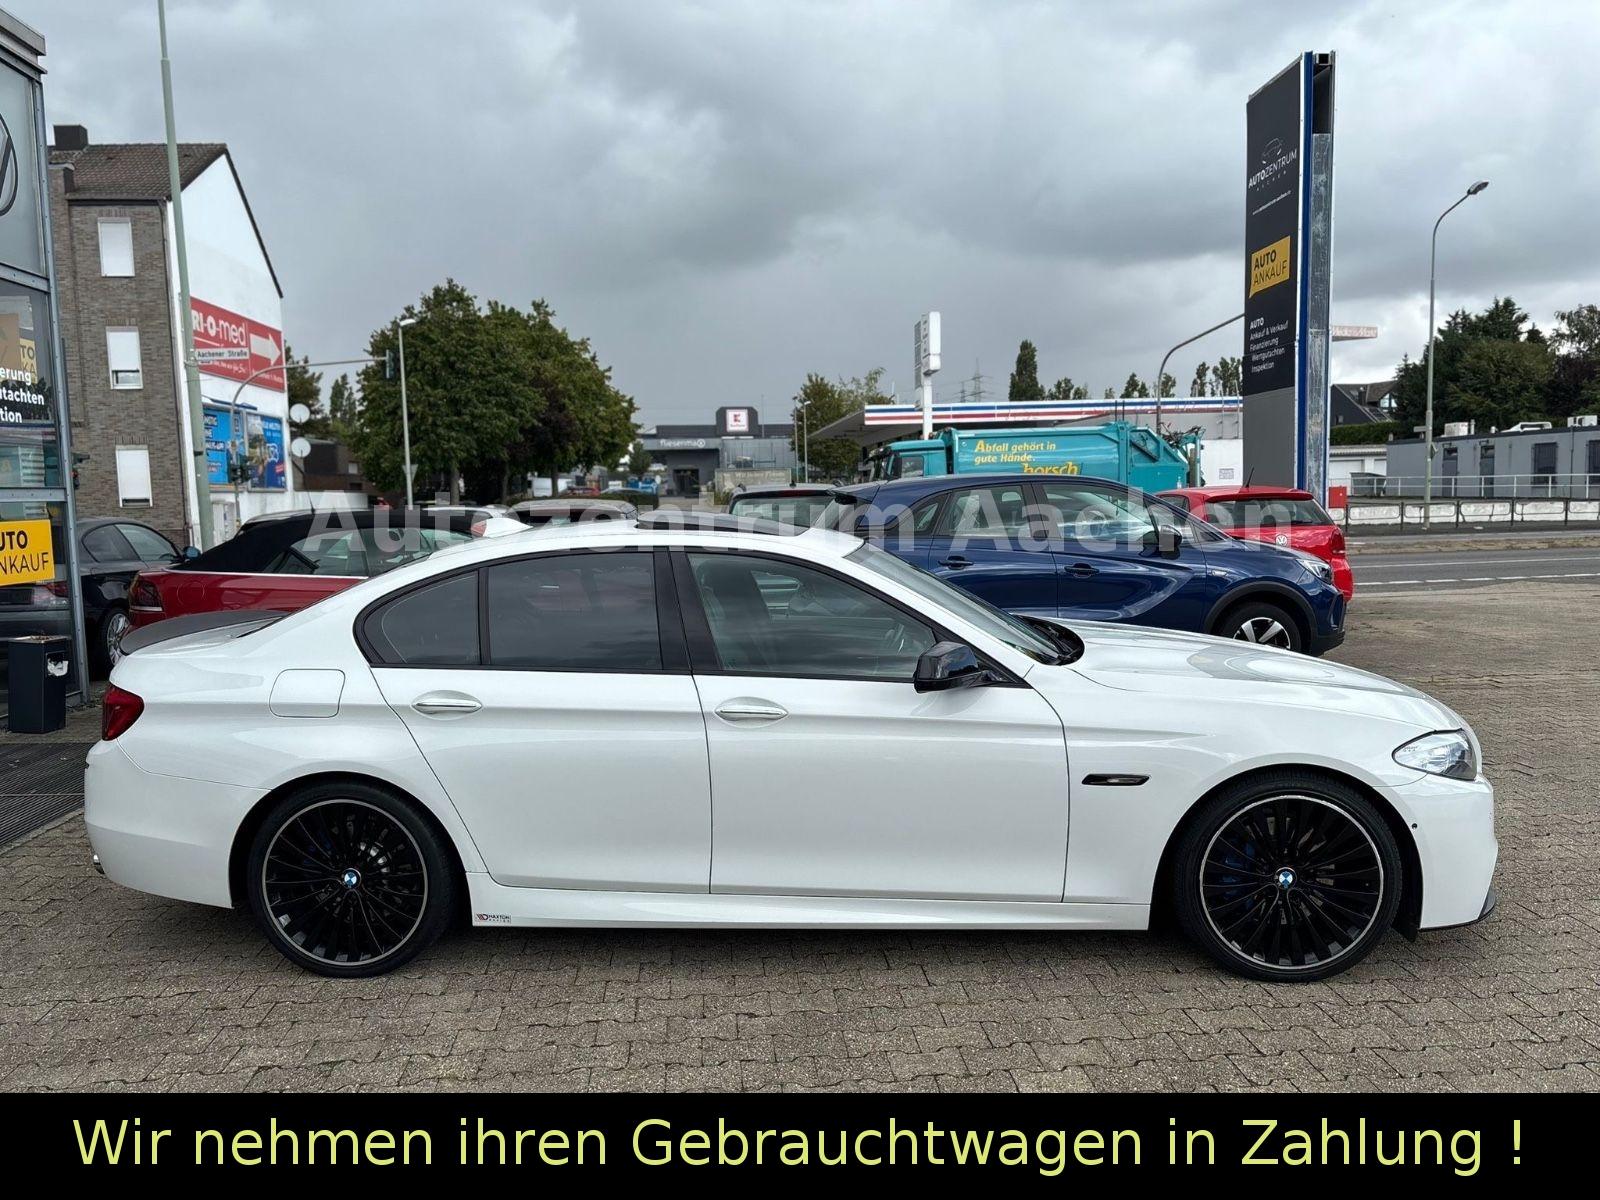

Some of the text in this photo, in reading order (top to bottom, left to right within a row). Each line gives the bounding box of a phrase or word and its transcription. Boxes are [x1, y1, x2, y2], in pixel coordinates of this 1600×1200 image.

[1248, 148, 1297, 189] AUTOZENTRUM
[1253, 249, 1277, 271] AUTO
[1253, 260, 1288, 286] ANKAUF
[1249, 317, 1265, 330] AUTO
[197, 350, 225, 358] Aachener
[0, 367, 32, 385] erung
[0, 386, 45, 405] tachten
[974, 440, 1056, 454] Abfall gehört in
[974, 454, 998, 465] gute
